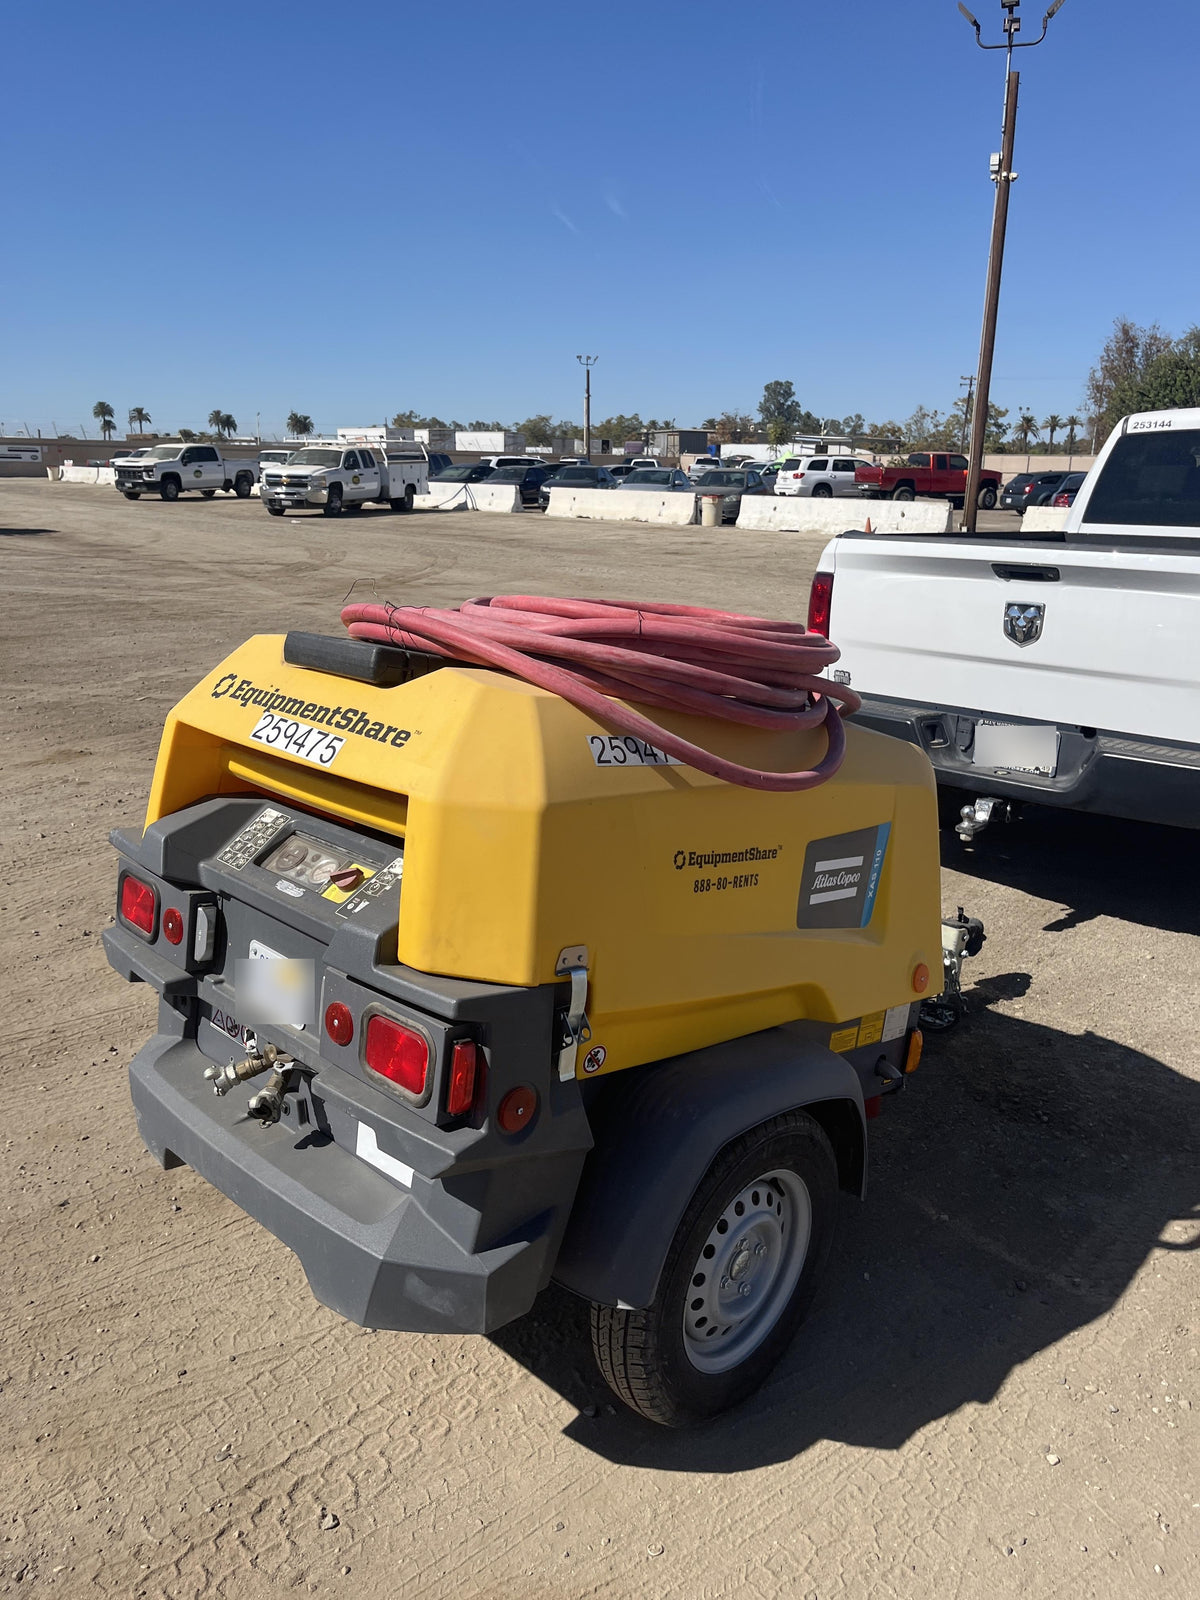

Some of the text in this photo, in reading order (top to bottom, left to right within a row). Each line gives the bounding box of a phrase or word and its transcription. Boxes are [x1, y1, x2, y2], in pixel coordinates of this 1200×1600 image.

[1133, 420, 1172, 430] 253144
[229, 679, 412, 748] EquipmentShare
[251, 714, 344, 764] 259475
[687, 847, 778, 868] EquipmentShare
[693, 873, 759, 893] 888-80-RENTS
[811, 871, 861, 890] Atlas Copco
